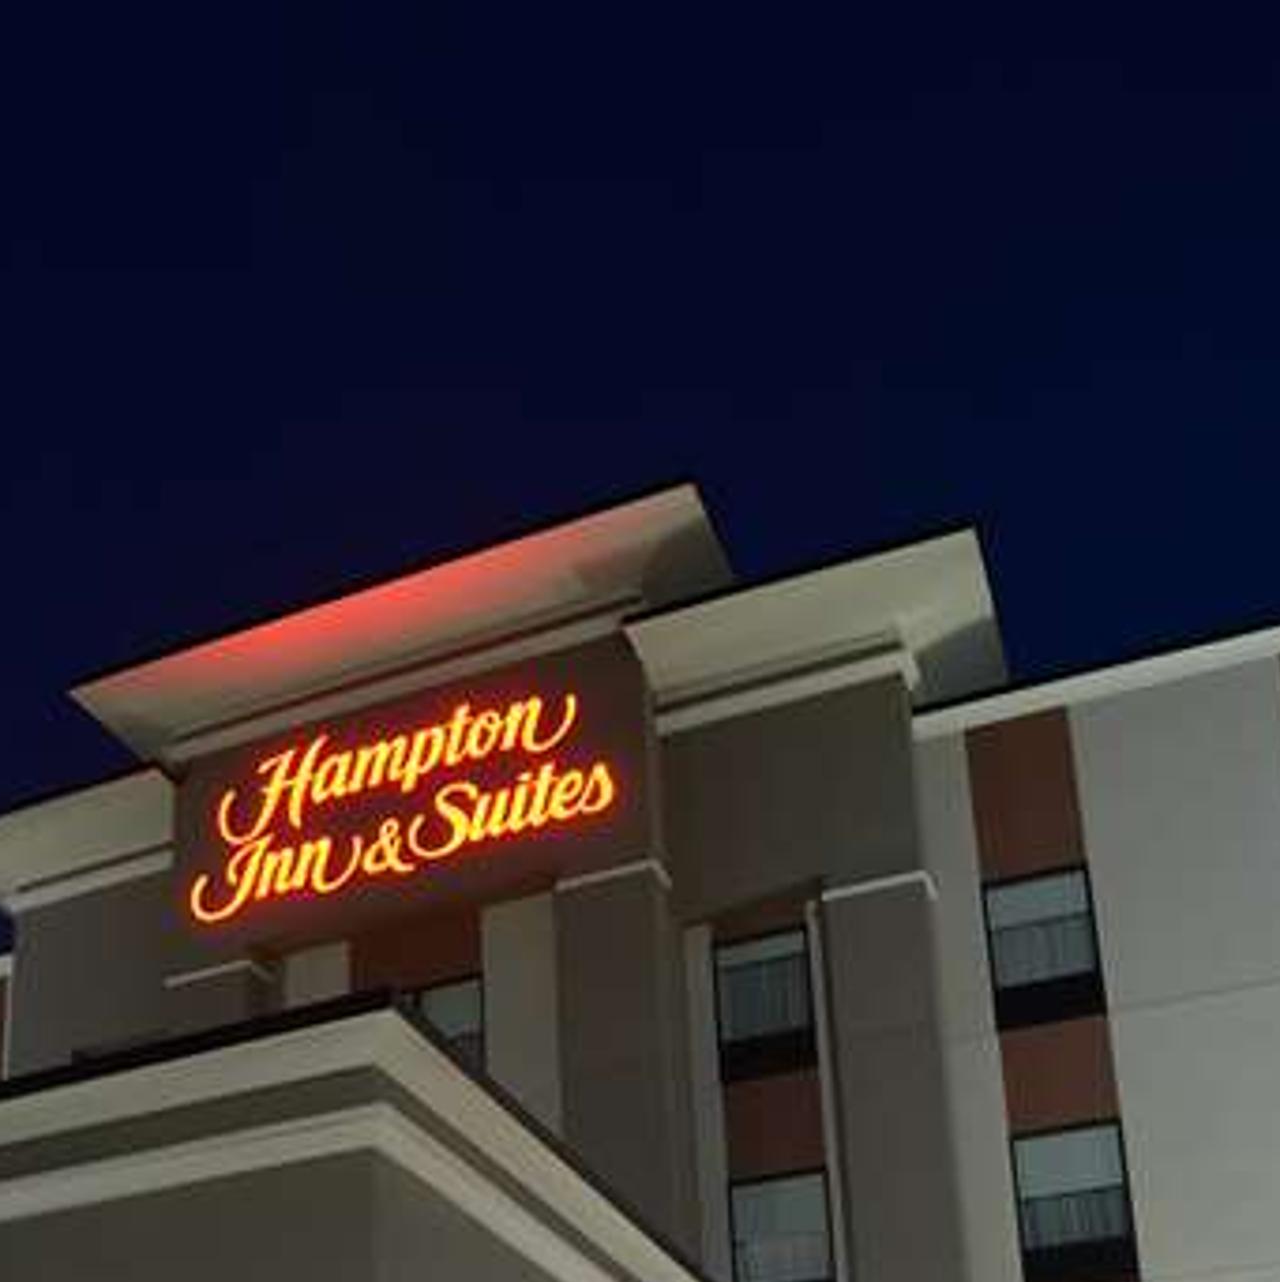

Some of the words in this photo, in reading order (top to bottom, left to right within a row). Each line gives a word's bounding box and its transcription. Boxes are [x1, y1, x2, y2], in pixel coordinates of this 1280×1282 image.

[189, 834, 365, 923] Inn
[362, 816, 416, 873] &
[407, 761, 616, 859] Suites
[219, 692, 577, 845] Hampton
